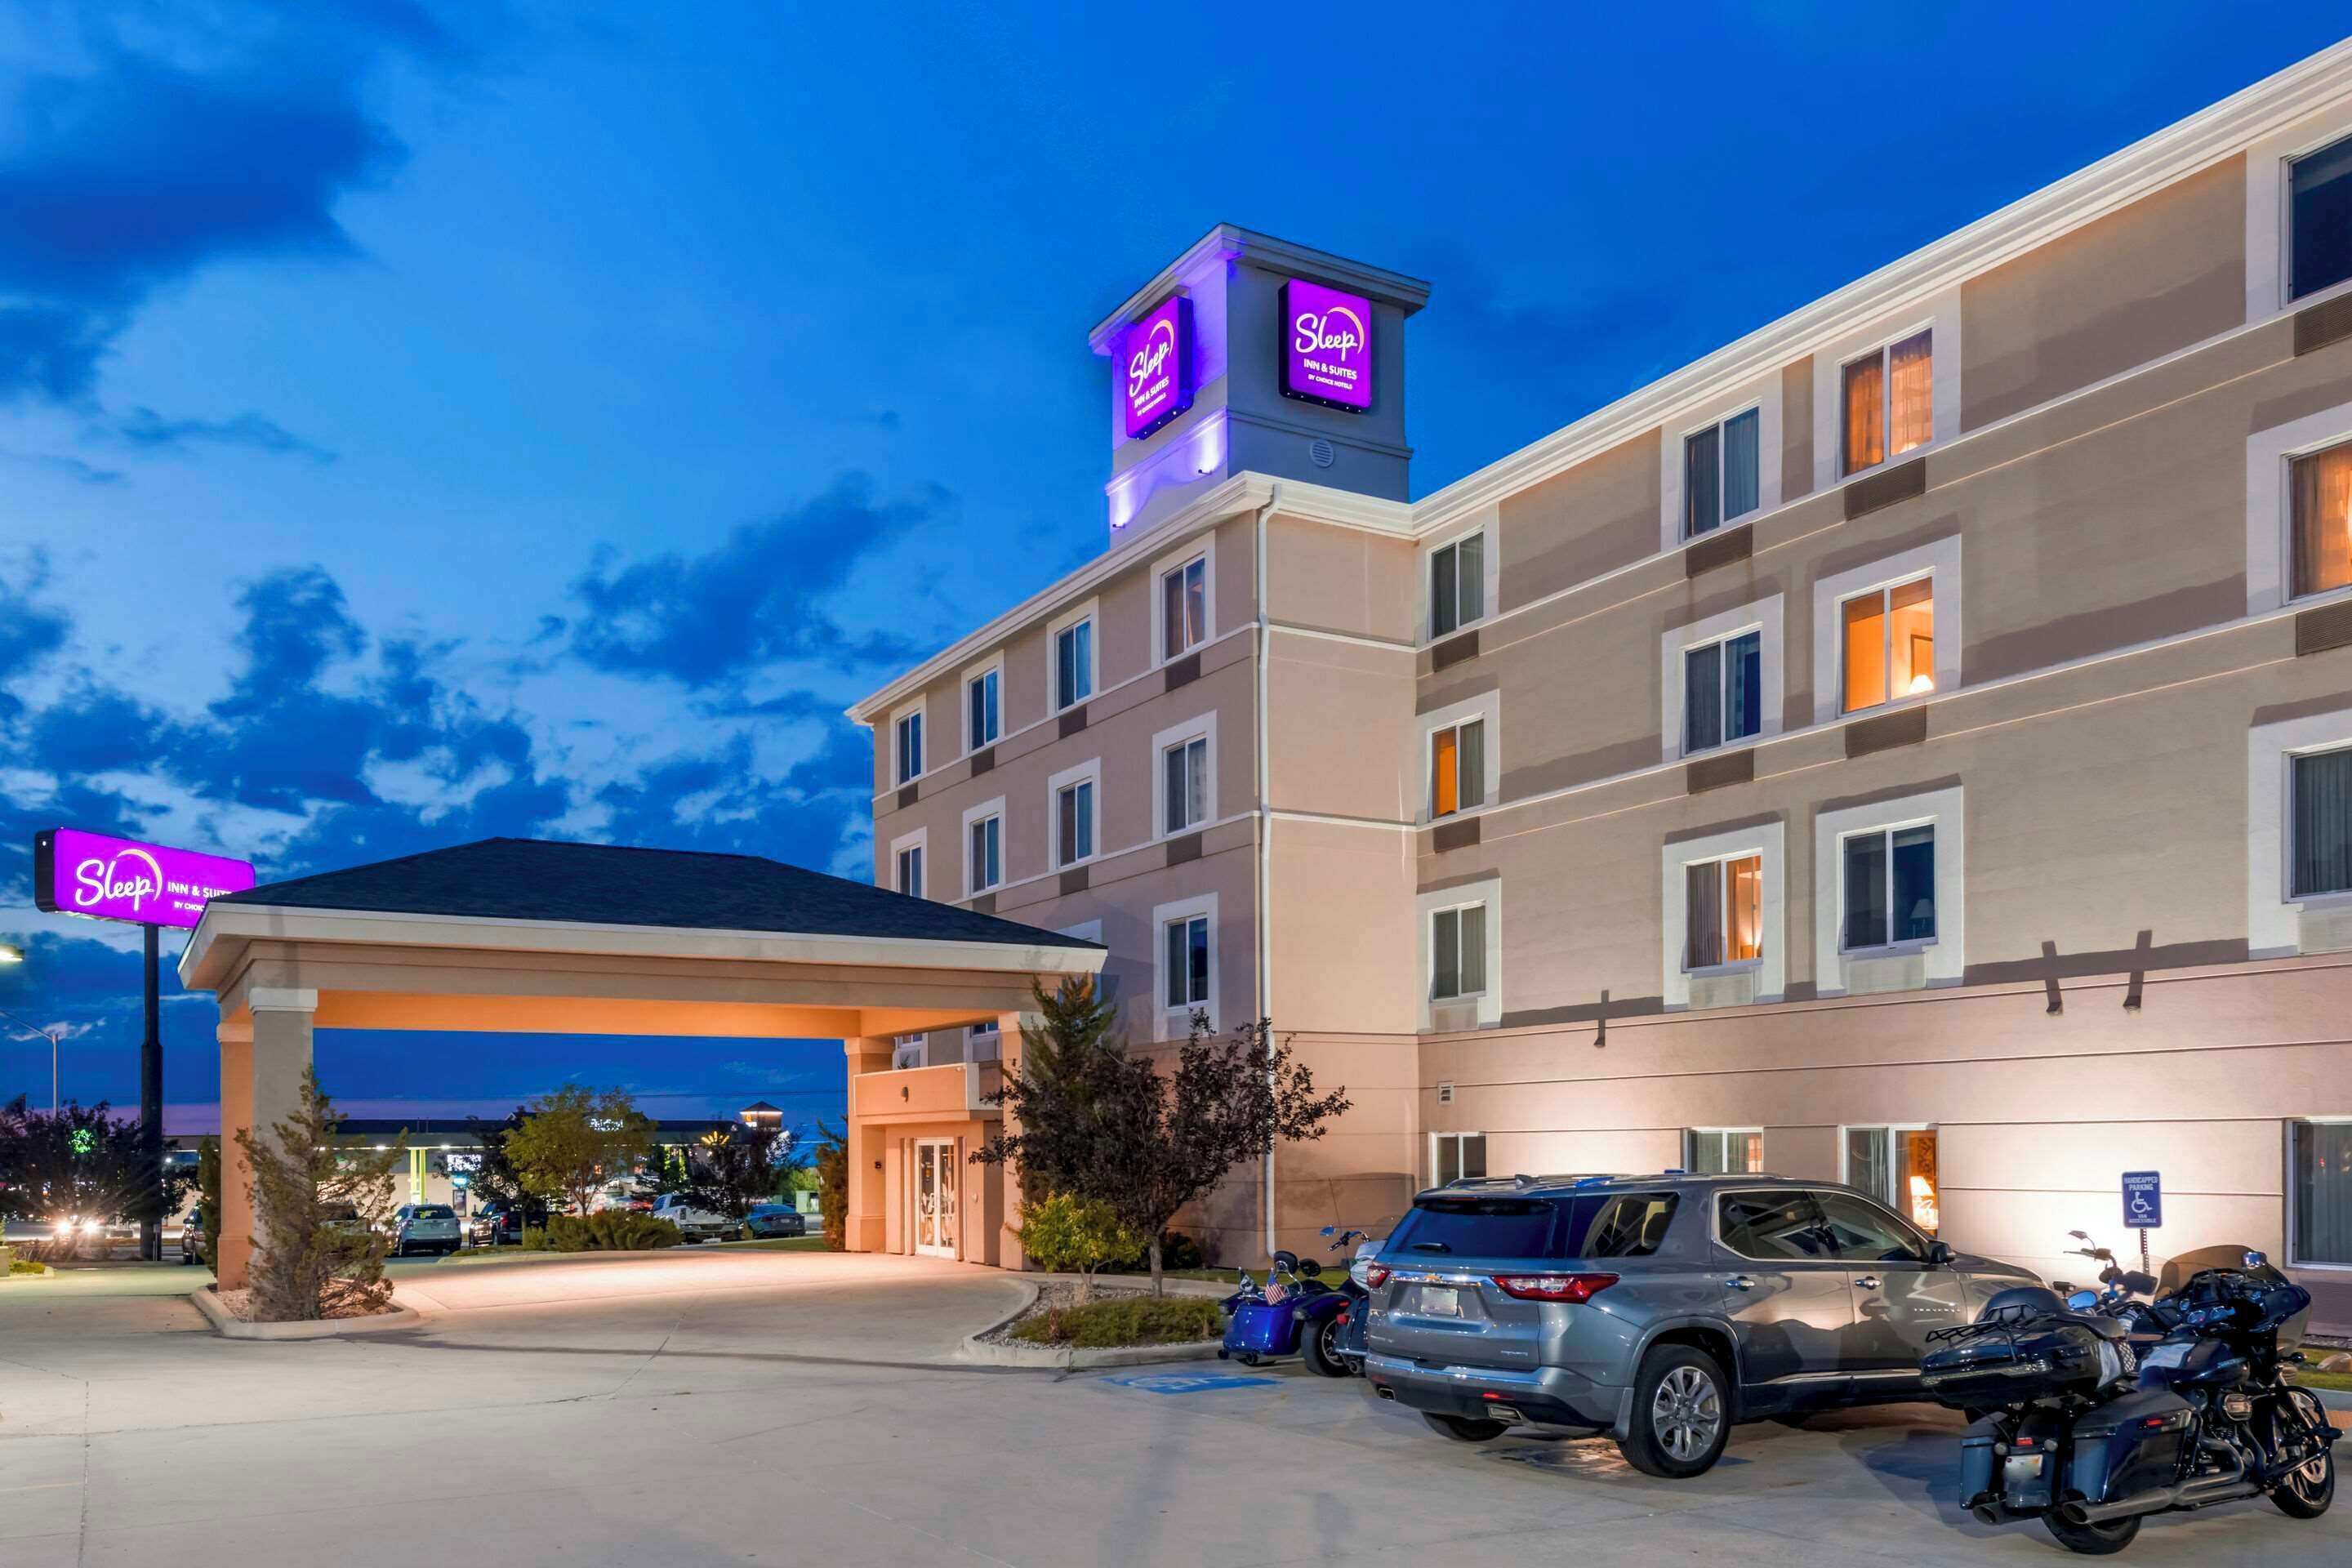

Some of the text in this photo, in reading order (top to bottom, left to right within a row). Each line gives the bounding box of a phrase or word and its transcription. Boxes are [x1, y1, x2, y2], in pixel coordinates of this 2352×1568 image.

[1295, 314, 1358, 362] Sleep
[1129, 341, 1169, 398] Sleep
[1303, 358, 1357, 381] INN & SUITES
[1315, 376, 1334, 385] CHOICE
[1134, 394, 1145, 408] INN
[1150, 376, 1169, 397] SUITES
[75, 859, 154, 911] Sleep
[167, 881, 189, 895] INN
[192, 885, 200, 897] &
[174, 901, 184, 909] BY
